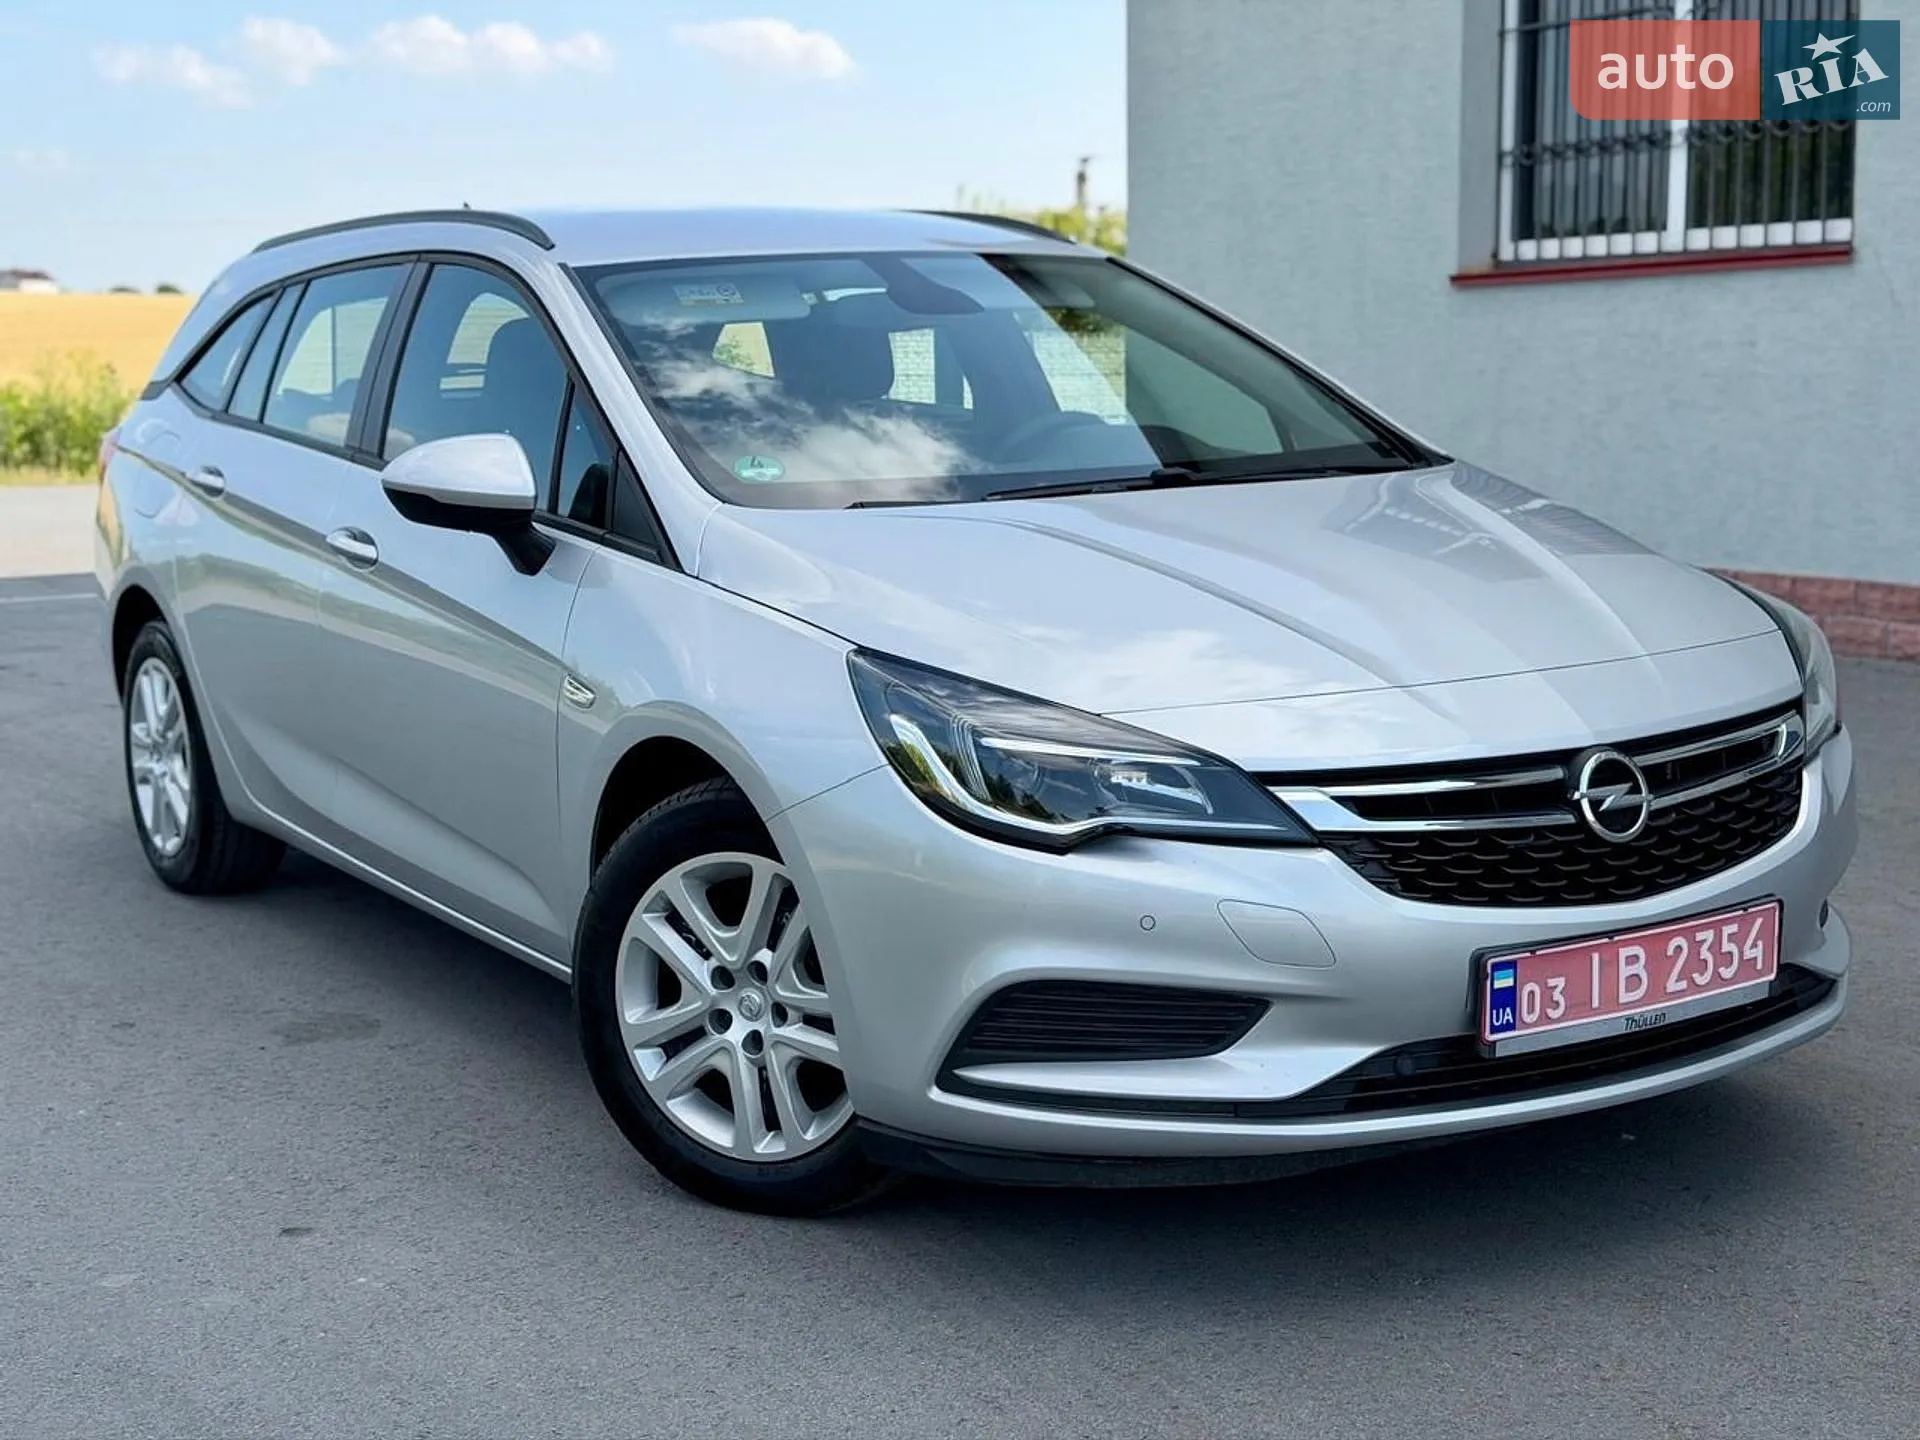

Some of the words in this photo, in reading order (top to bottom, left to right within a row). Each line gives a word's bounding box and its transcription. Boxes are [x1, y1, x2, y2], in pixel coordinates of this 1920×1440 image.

[1520, 976, 1567, 1024] 03
[1665, 917, 1764, 994] 2354
[1492, 1007, 1514, 1026] UA
